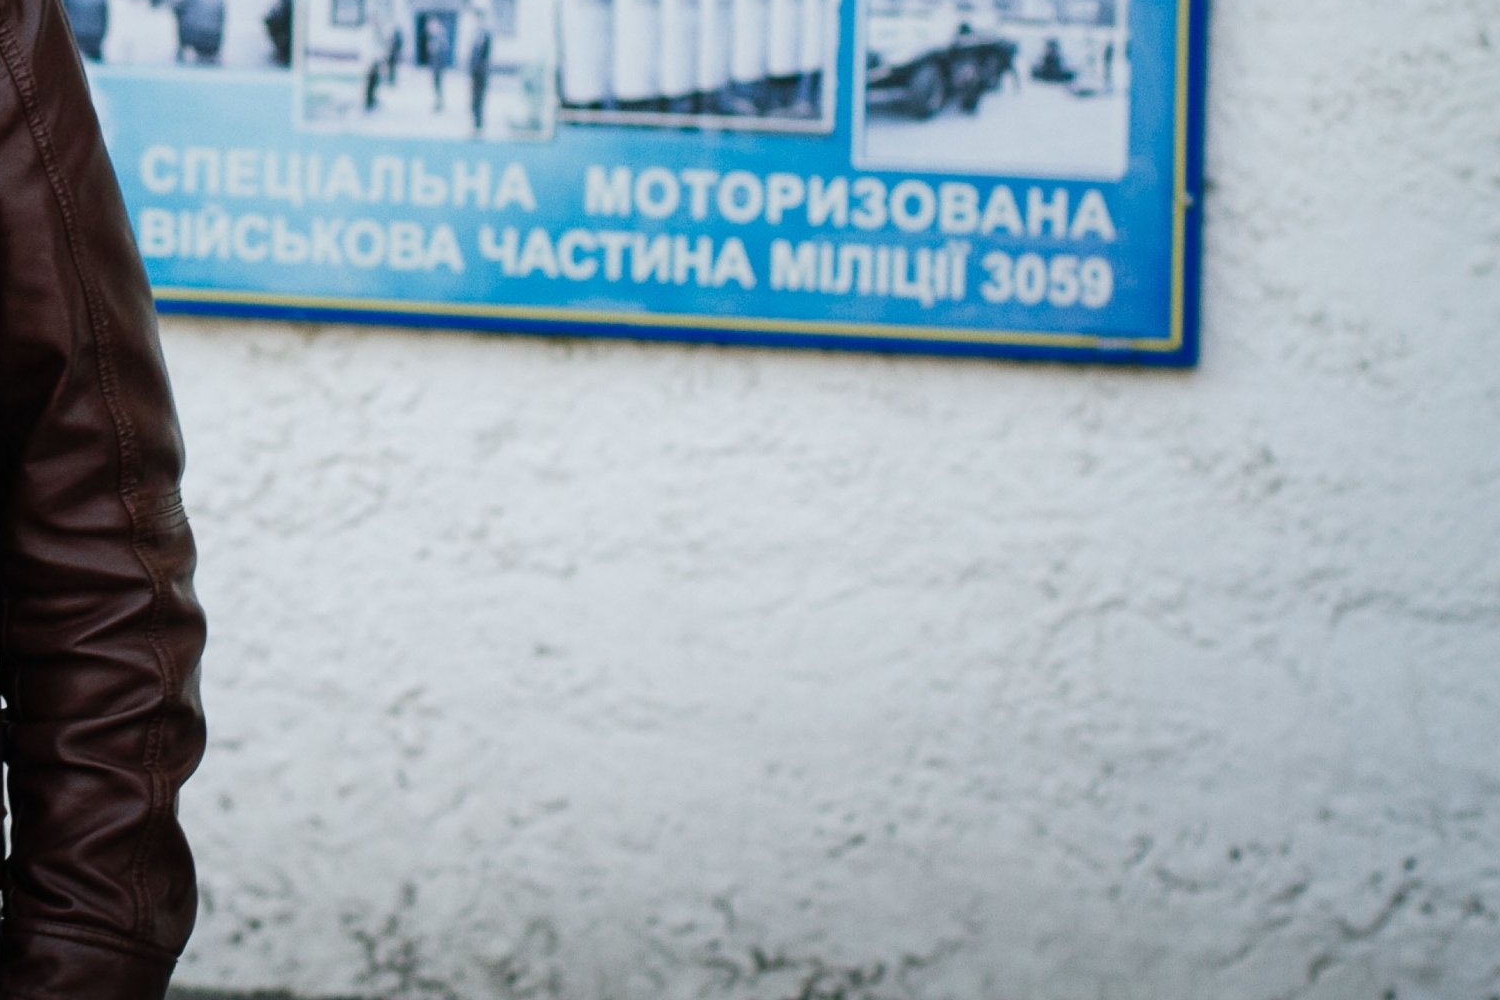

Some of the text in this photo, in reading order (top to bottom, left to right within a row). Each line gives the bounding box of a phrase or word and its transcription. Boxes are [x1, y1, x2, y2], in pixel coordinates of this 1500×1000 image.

[139, 145, 1116, 242] СПЕЦІАЛЬНА МОТОРИЗОВАНА
[141, 206, 1114, 309] ВІЙСЬКОВА ЧАСТИНА МІЛІЦІЇ 3059
